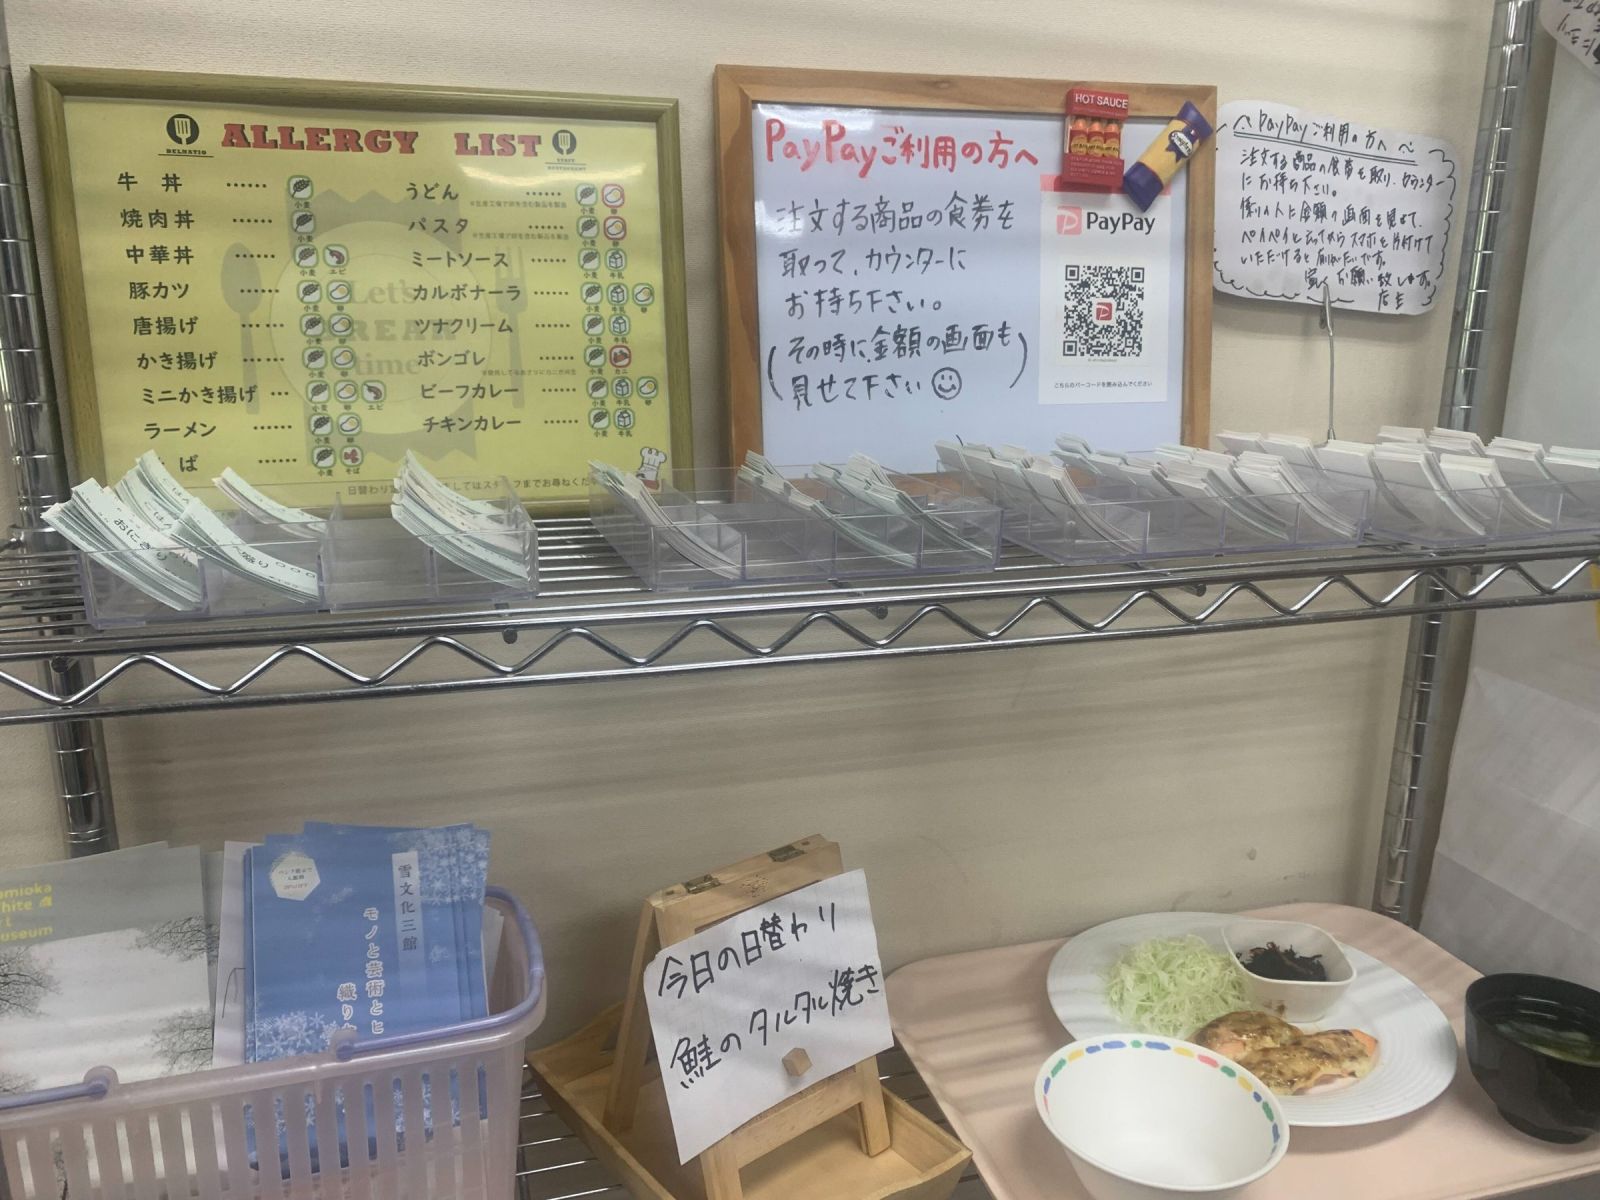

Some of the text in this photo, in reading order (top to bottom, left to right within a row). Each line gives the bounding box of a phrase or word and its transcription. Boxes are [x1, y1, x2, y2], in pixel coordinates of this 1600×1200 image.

[1075, 93, 1129, 109] HOT SAUCE
[221, 123, 542, 157] ALLERGY LIST
[406, 182, 459, 201] うどん
[120, 207, 195, 229] 焼肉丼
[408, 217, 469, 233] パスタ
[1086, 211, 1156, 236] PayPay
[126, 244, 194, 265] 中華丼
[411, 250, 509, 268] ミートソース
[129, 281, 190, 300] 豚カツ
[413, 283, 522, 301] カルボナーラ
[133, 316, 199, 336] 唐揚げ
[414, 317, 514, 335] ツナクリーム
[137, 351, 218, 370] かき揚げ
[417, 350, 486, 368] ボンゴレ
[142, 385, 257, 405] ミニかき揚げ
[420, 383, 520, 400] ビーフカレー
[144, 421, 217, 439] ラーメン
[423, 416, 521, 433] チキンカレー
[0, 898, 33, 913] hite
[397, 863, 419, 952] 雪文化三館
[658, 902, 836, 999] 今日の日替わり
[669, 964, 880, 1089] 鮭のタルタル焼き
